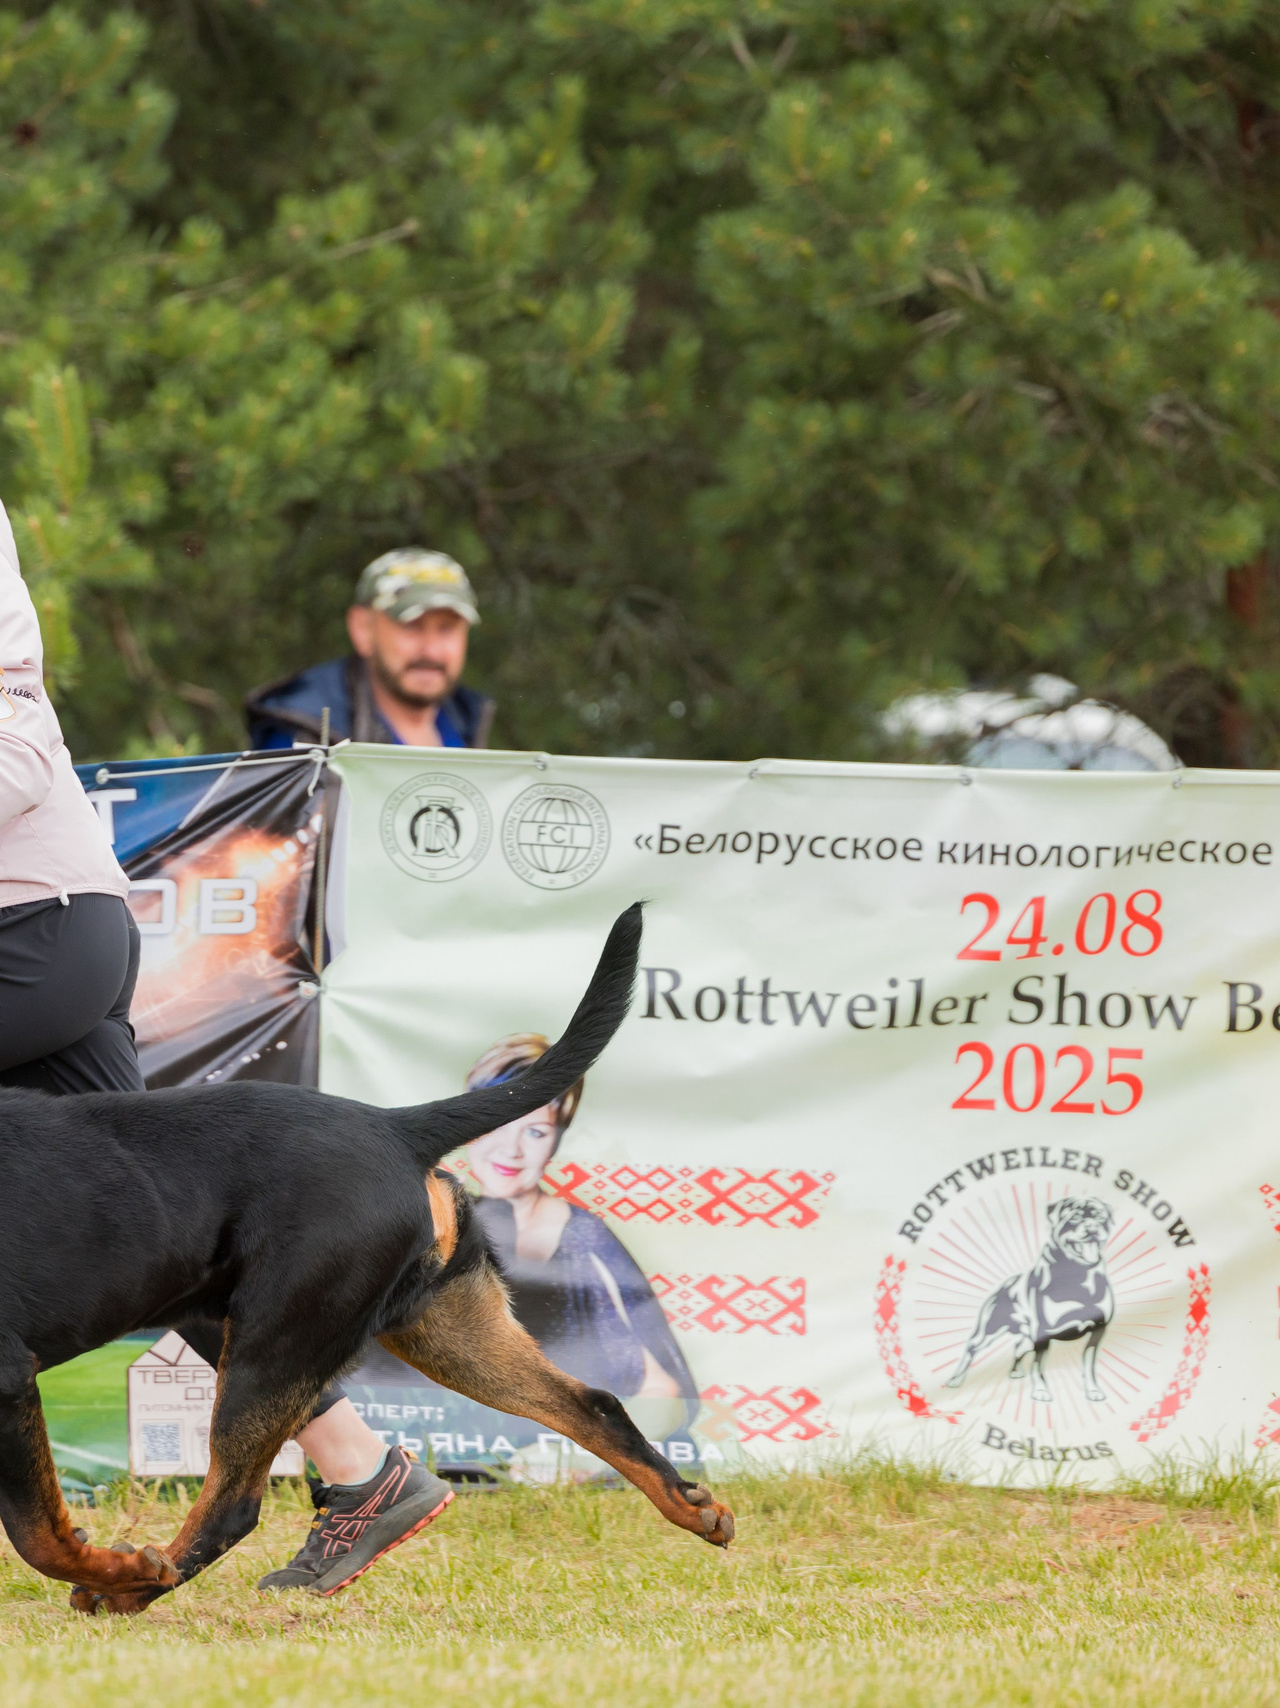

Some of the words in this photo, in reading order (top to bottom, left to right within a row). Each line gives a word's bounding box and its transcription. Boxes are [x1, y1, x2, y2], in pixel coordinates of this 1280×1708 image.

[537, 825, 574, 844] FCI
[633, 824, 923, 865] «Белорусское
[938, 838, 1273, 868] кинологическое
[956, 889, 1163, 961] 24.08
[640, 966, 989, 1030] Rottweiler
[1008, 974, 1196, 1032] Show
[951, 1041, 1145, 1115] 2025
[899, 1147, 1104, 1244] ROTTWEILER
[1113, 1169, 1197, 1250] SHOW
[981, 1423, 1114, 1463] Belarus
